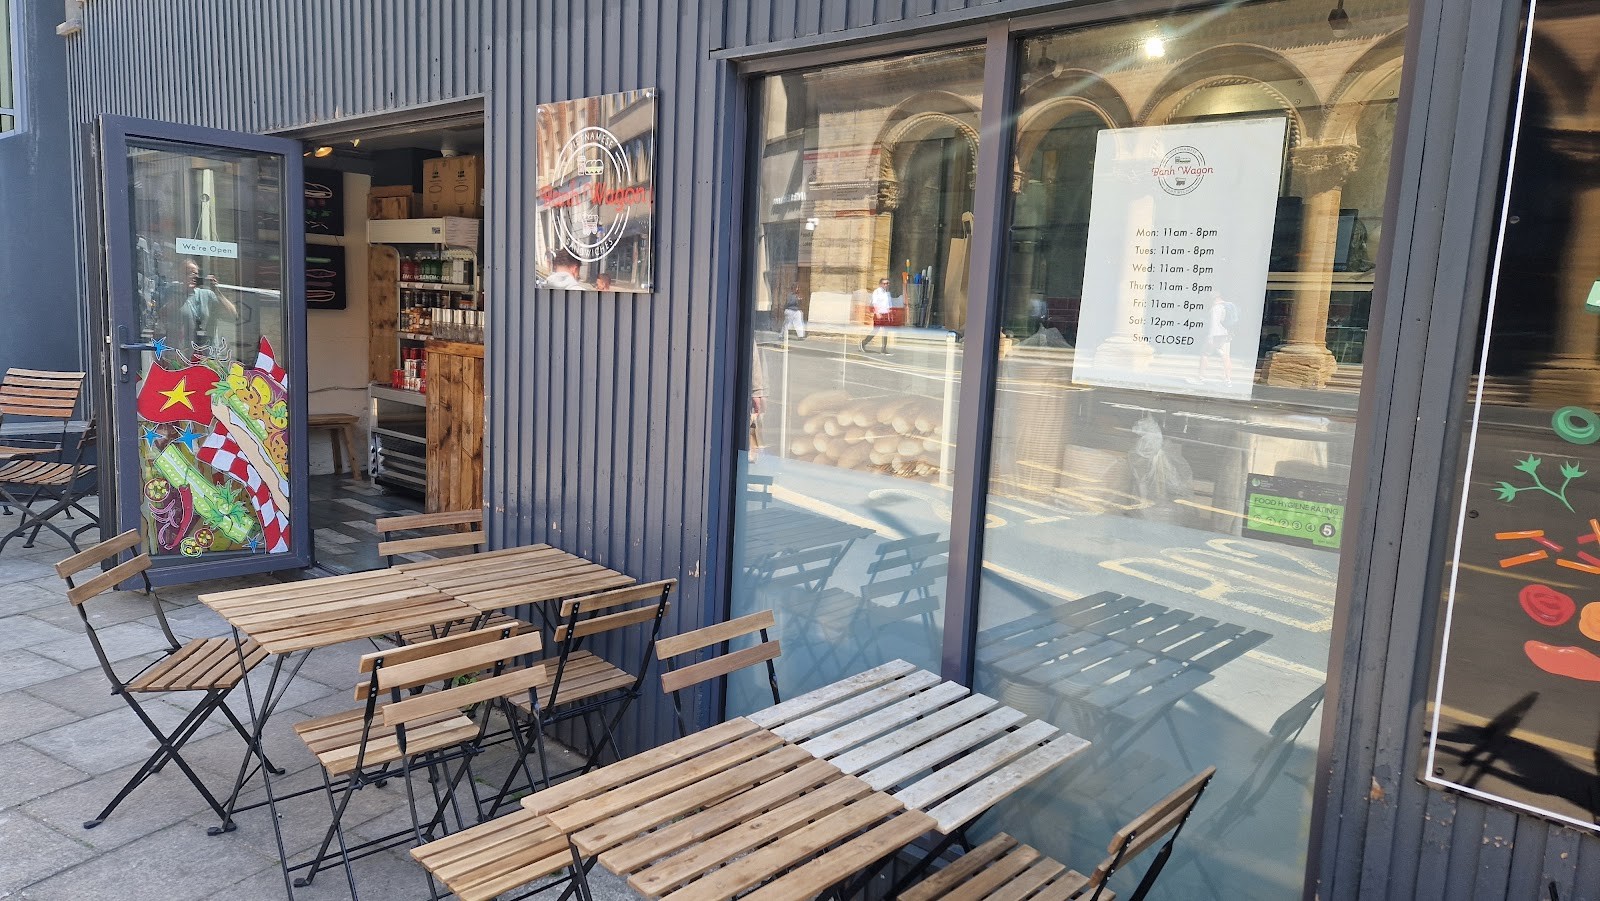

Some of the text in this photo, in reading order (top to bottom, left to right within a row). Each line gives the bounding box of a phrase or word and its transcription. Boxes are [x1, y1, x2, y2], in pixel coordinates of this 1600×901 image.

[568, 131, 614, 151] VIETNAMESE
[1152, 164, 1214, 177] Banh Wagon
[583, 181, 646, 213] Wagon
[1136, 228, 1159, 237] Mon:
[1164, 228, 1188, 237] 11am
[1196, 227, 1218, 239] 8pm
[182, 243, 232, 255] We're Open
[565, 237, 613, 257] SANDWICHES
[1135, 246, 1156, 255] Tues:
[1161, 246, 1185, 255] 11am
[1193, 246, 1215, 257] 8pm
[1132, 263, 1155, 272] Wed:
[1160, 263, 1184, 272] 11am
[1192, 264, 1214, 276] 8pm
[1129, 281, 1154, 290] Thurs:
[1159, 282, 1183, 291] 11am
[1191, 282, 1213, 294] 8pm
[1133, 299, 1147, 308] Fri:
[1151, 299, 1175, 309] 11am
[1183, 300, 1204, 312] 8pm
[1128, 316, 1146, 325] Sat:
[1150, 317, 1174, 328] 12pm
[1183, 318, 1204, 330] 4pm
[1132, 333, 1195, 346] Sun: CLOSED
[1254, 497, 1339, 515] FOOD HYGIENE RATING
[1322, 524, 1332, 536] 5
